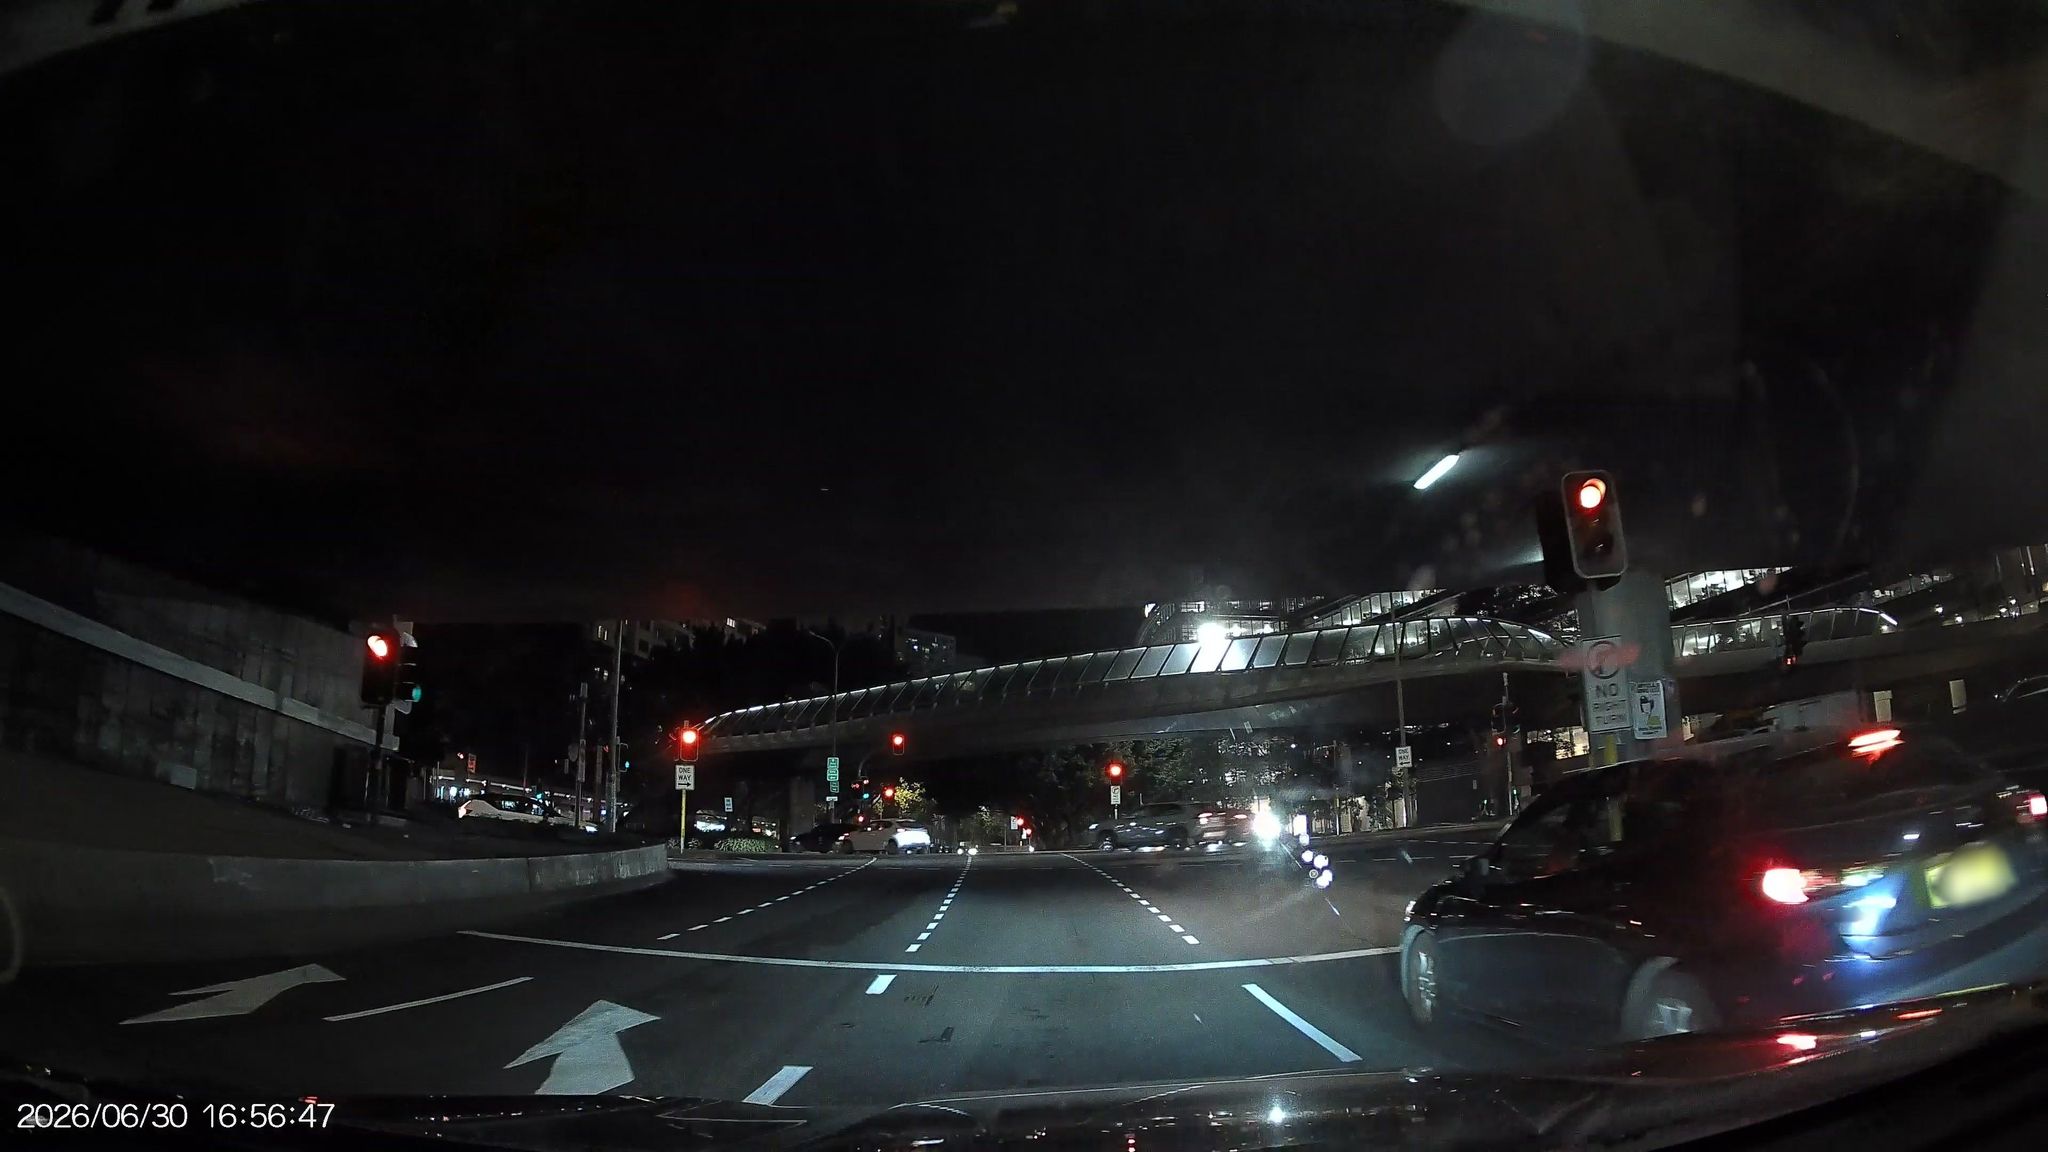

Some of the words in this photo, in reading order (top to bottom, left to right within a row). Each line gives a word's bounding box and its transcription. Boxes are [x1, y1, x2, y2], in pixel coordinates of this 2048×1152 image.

[1594, 683, 1618, 697] NO
[1592, 699, 1627, 713] RIGHT
[1595, 712, 1627, 725] TURN
